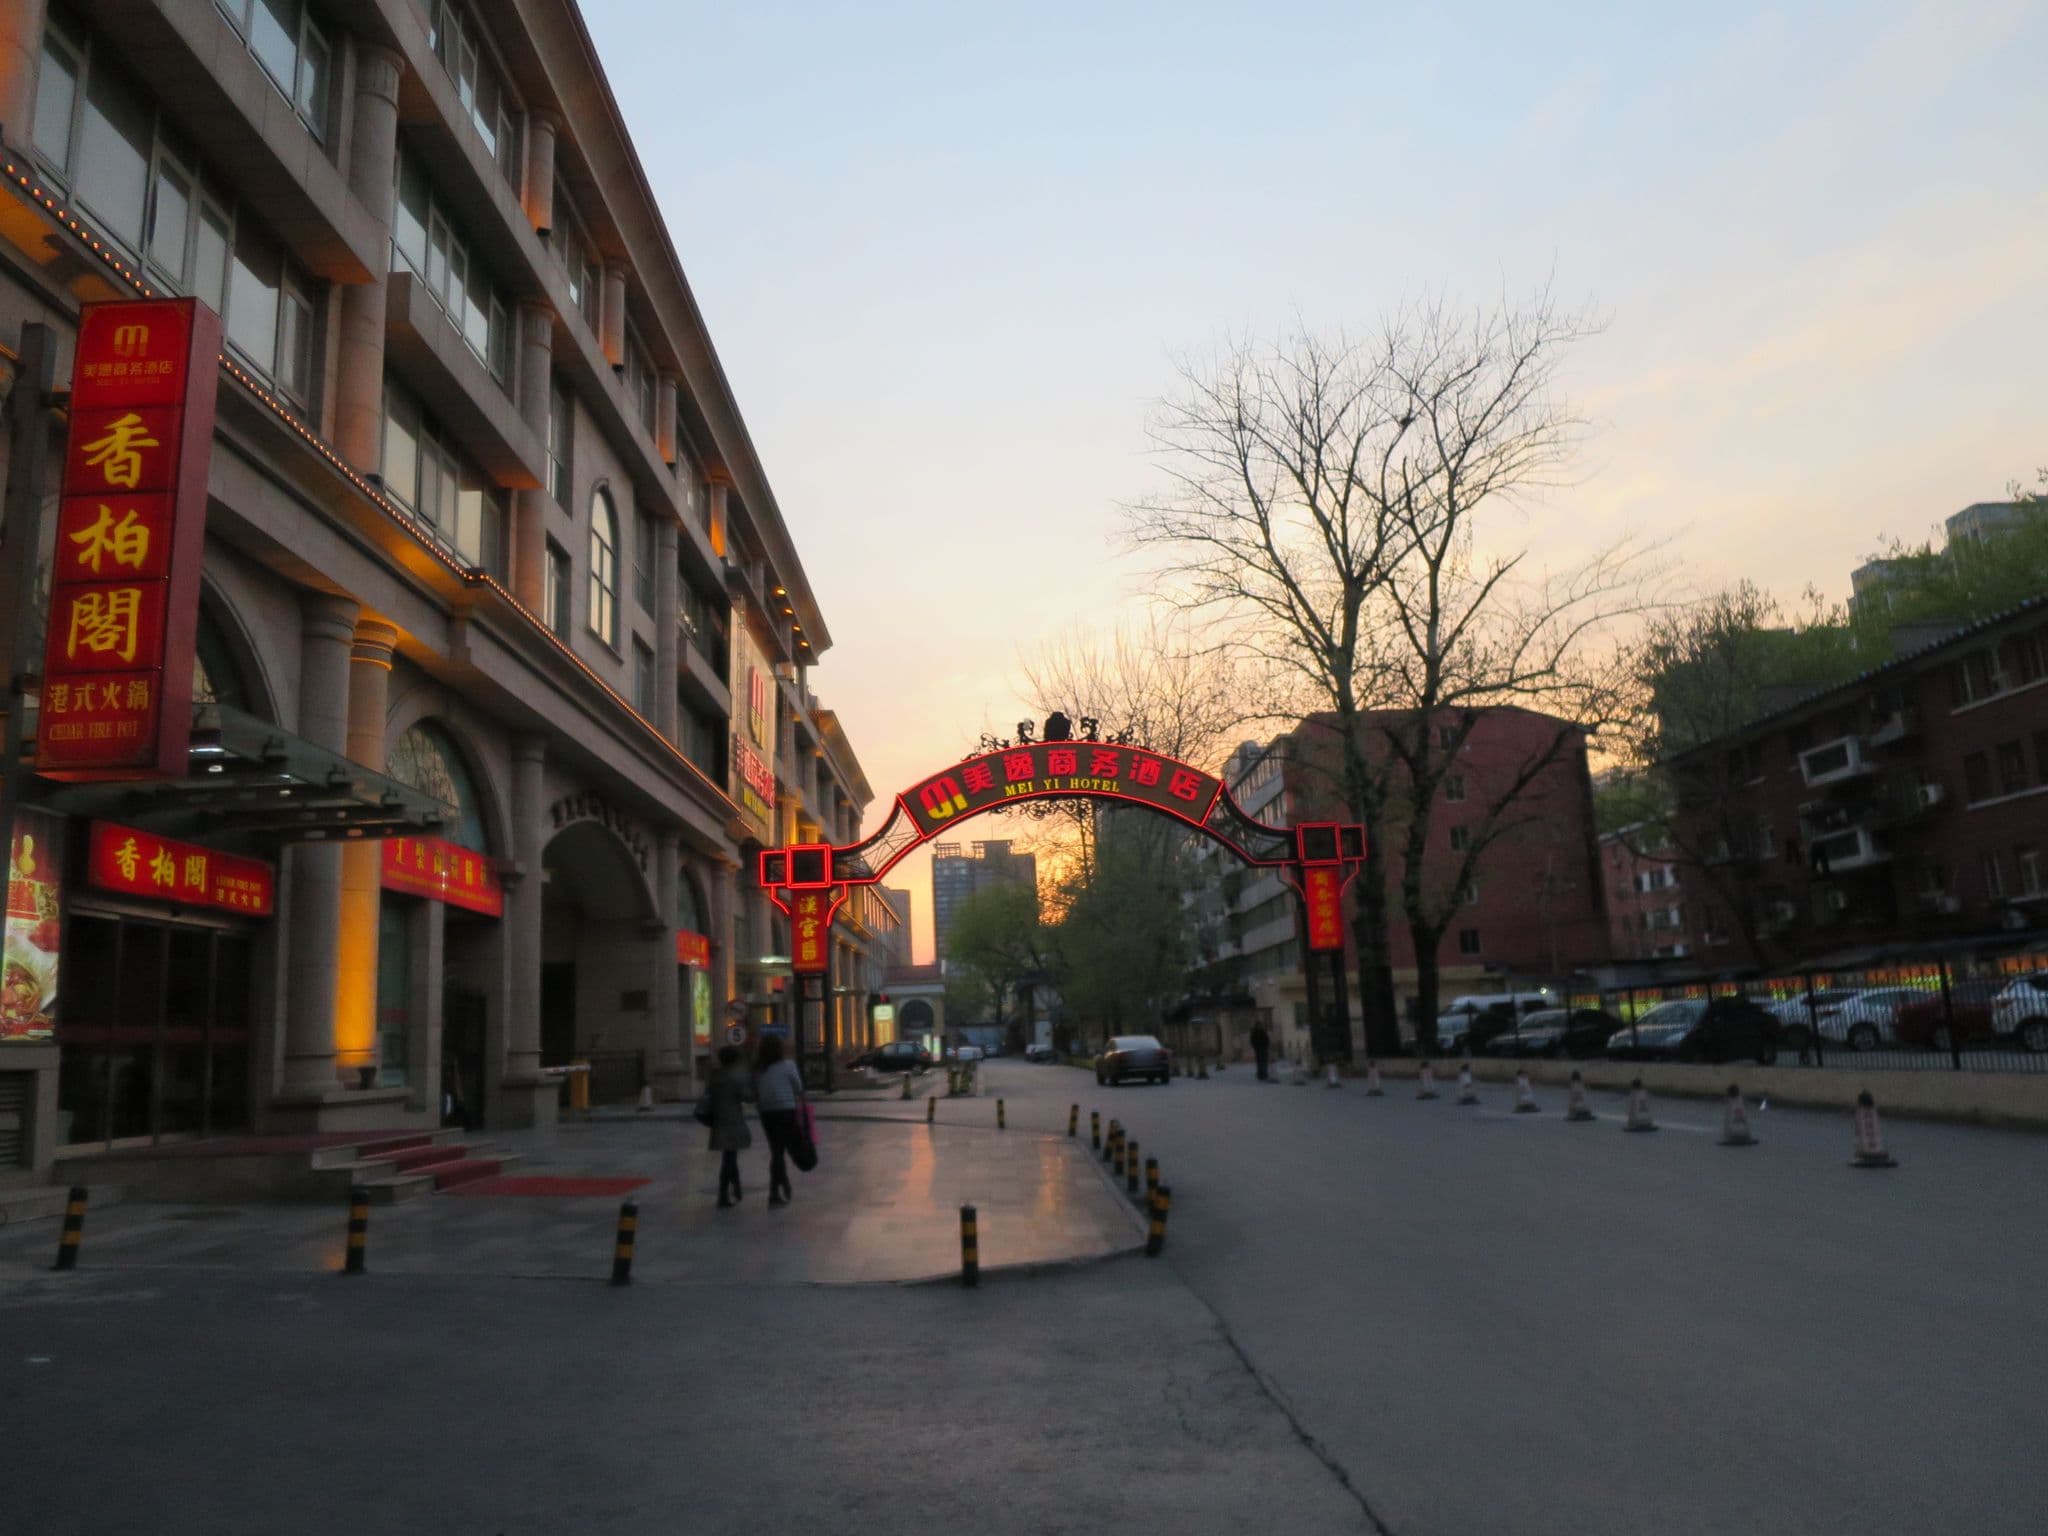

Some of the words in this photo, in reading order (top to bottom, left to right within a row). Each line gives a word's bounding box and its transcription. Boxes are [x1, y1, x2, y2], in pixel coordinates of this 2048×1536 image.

[962, 749, 1203, 802] 美逸商务酒店
[1003, 780, 1035, 797] MEI
[1043, 778, 1060, 792] YI
[1069, 777, 1121, 793] HOTEL
